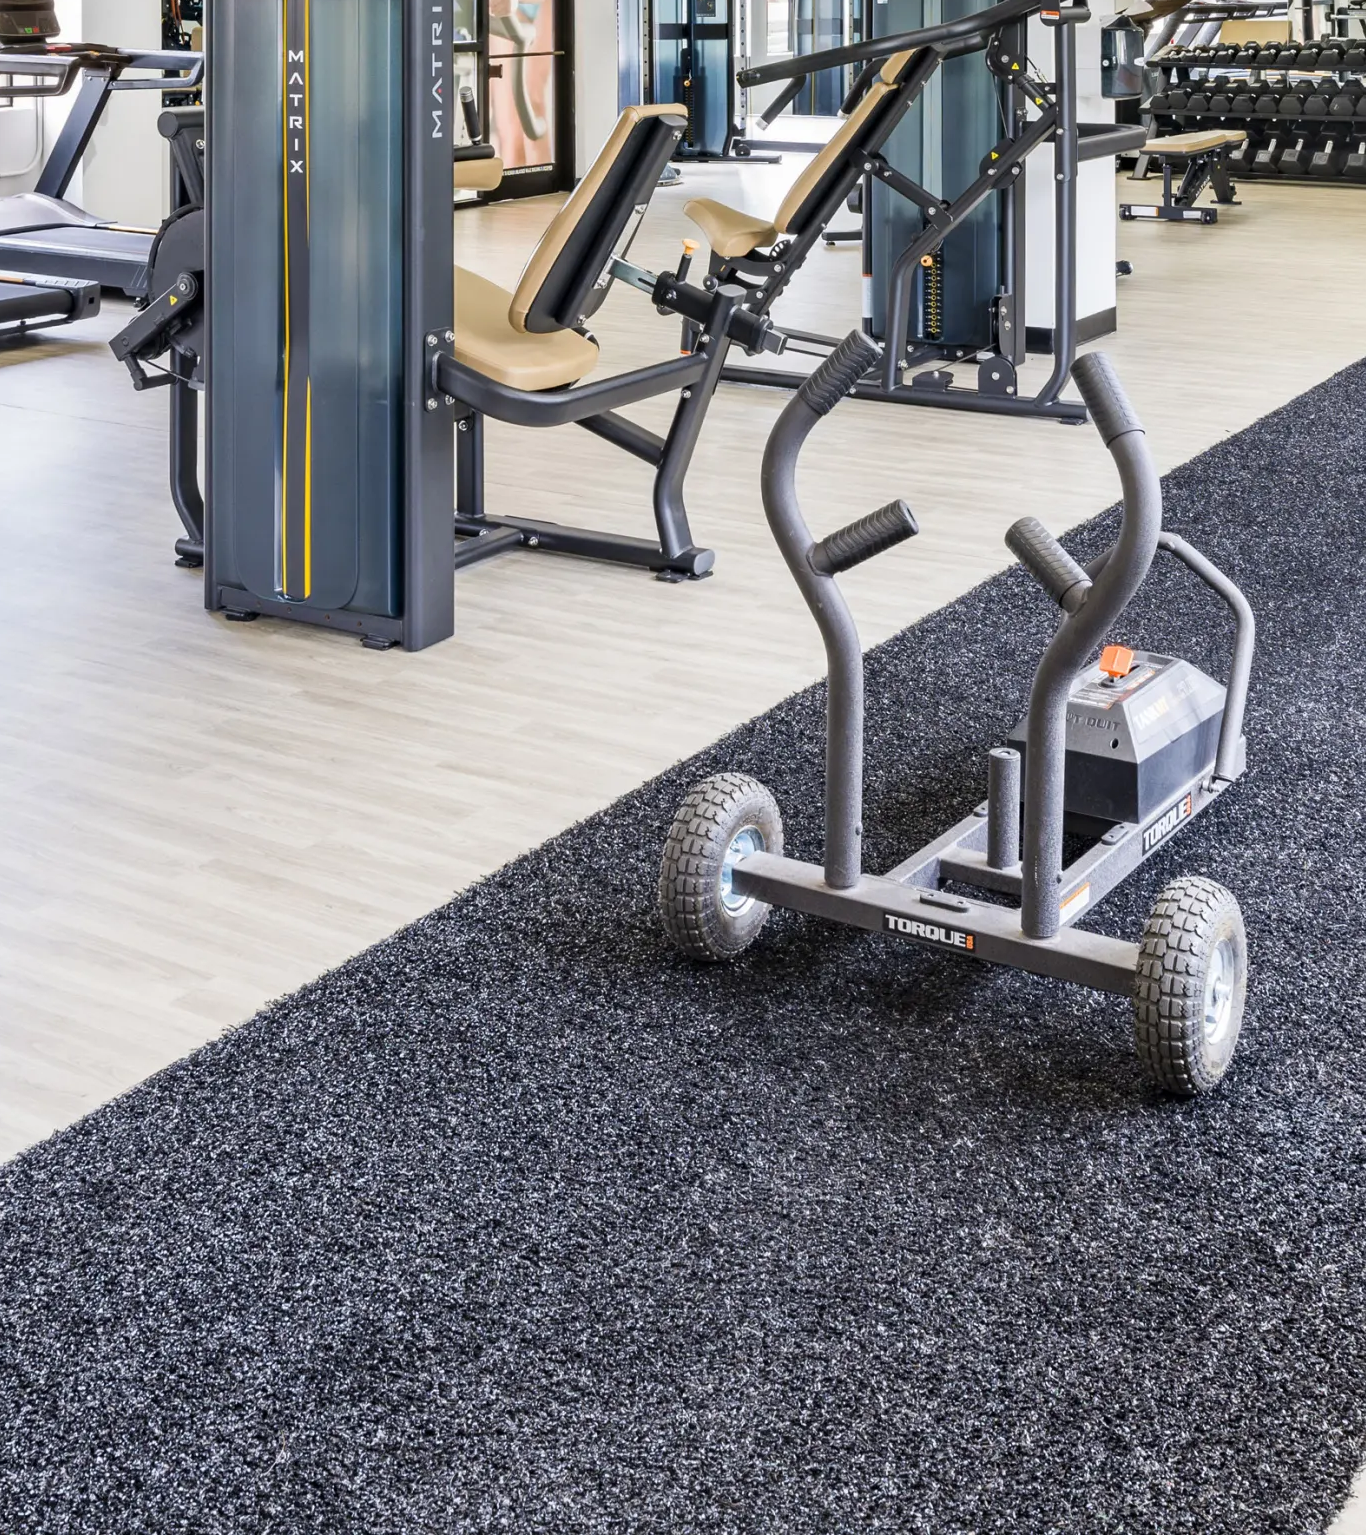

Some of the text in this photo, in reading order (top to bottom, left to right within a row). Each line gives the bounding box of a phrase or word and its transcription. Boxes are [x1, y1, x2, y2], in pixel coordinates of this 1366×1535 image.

[288, 50, 304, 173] MATRIX
[1144, 797, 1188, 851] TORQUE
[885, 914, 967, 947] TORQUE
